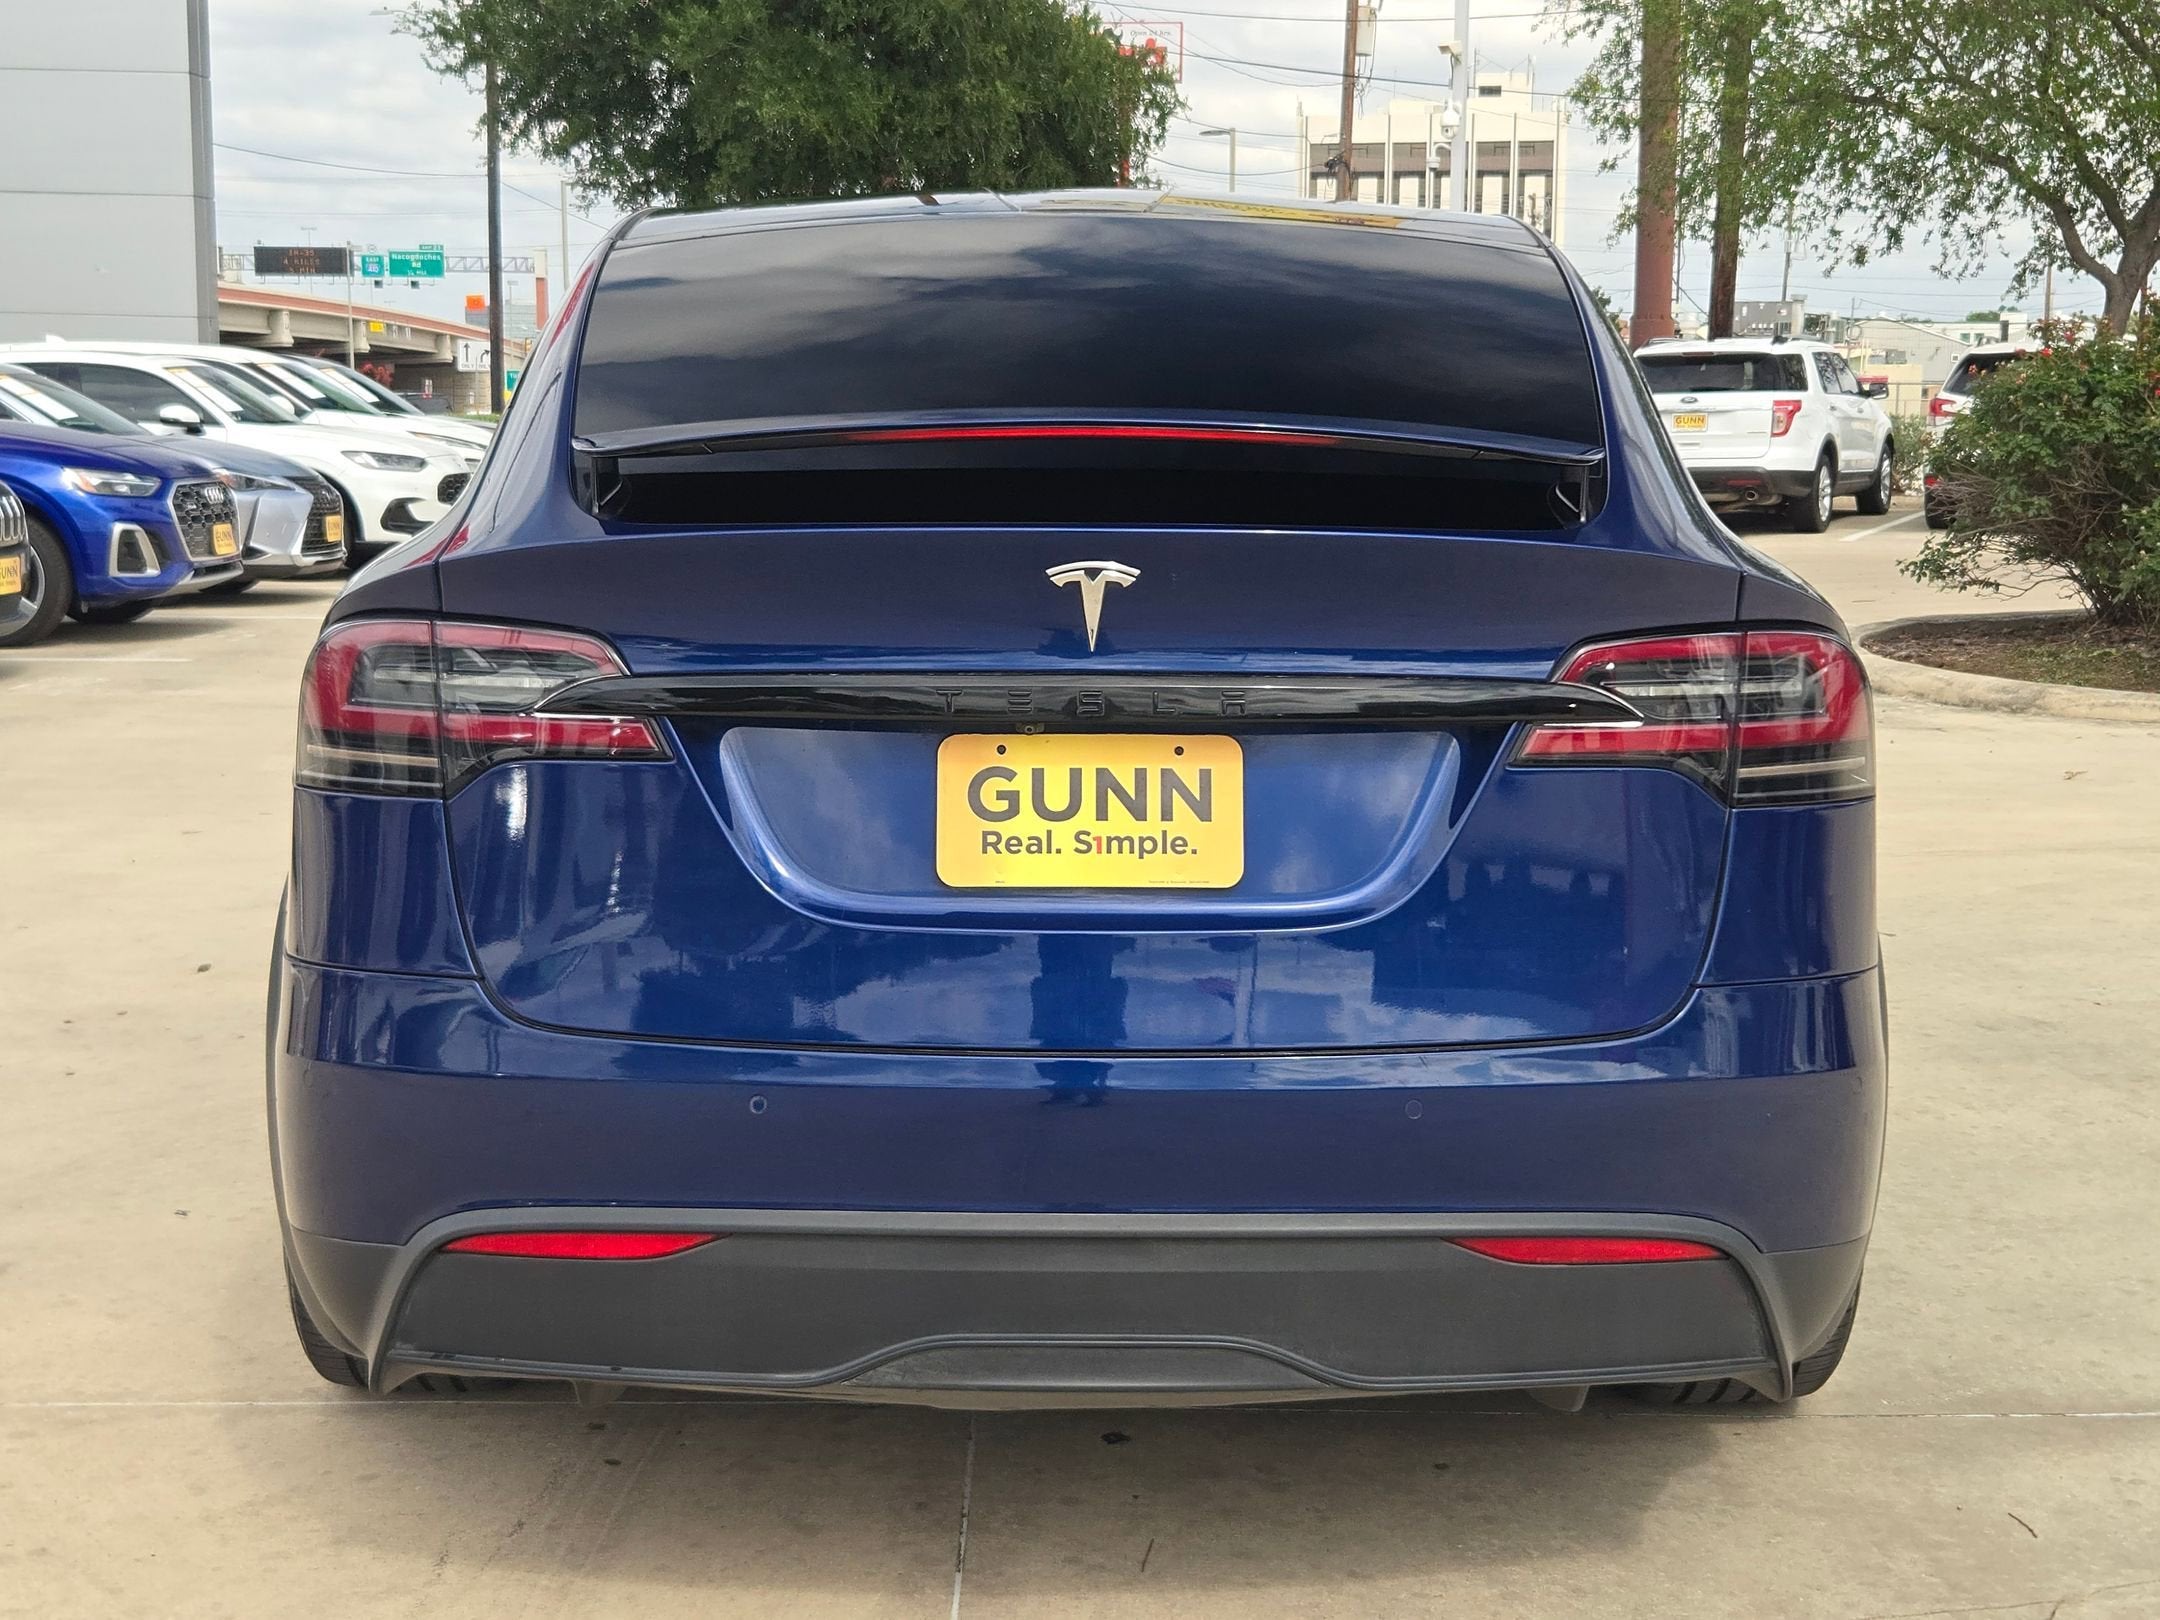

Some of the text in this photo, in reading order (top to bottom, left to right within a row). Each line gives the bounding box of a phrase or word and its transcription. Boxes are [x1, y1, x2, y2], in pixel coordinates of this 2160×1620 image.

[1675, 416, 1705, 424] GUNN
[936, 689, 1246, 716] TESLA
[967, 766, 1212, 822] GUNN
[981, 830, 1062, 855] Real.
